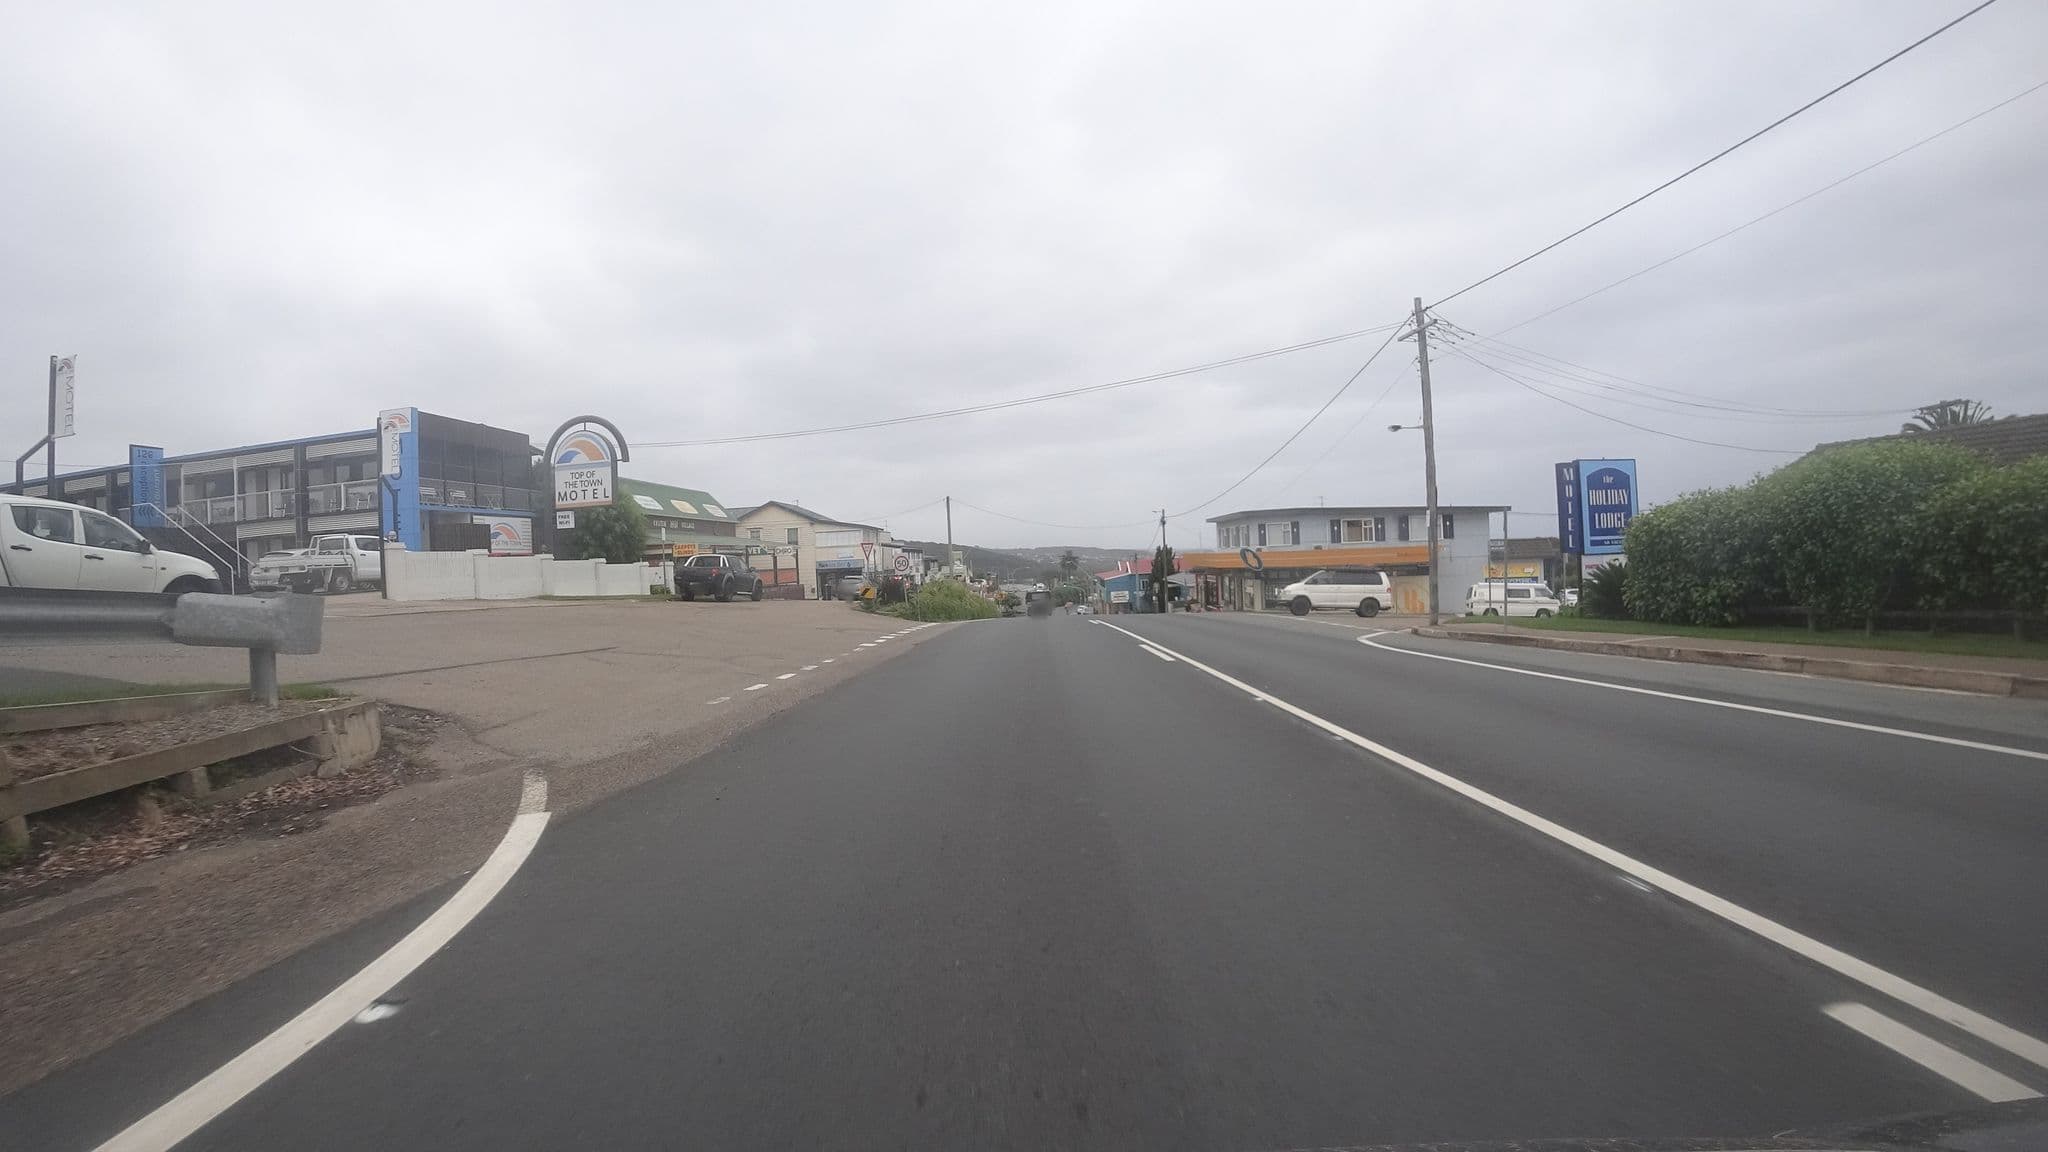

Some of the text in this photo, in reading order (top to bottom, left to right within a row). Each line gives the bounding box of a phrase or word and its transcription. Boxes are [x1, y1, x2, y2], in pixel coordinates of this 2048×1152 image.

[65, 375, 74, 433] MOTEL
[391, 431, 400, 474] MOTEL
[570, 470, 596, 480] TOP OF
[564, 478, 603, 489] THE TOWN
[557, 488, 609, 502] MOTEL
[1589, 489, 1629, 505] HOLIDAY
[1563, 467, 1575, 548] MOTEL
[1594, 512, 1626, 528] LODGE
[896, 559, 907, 569] 50
